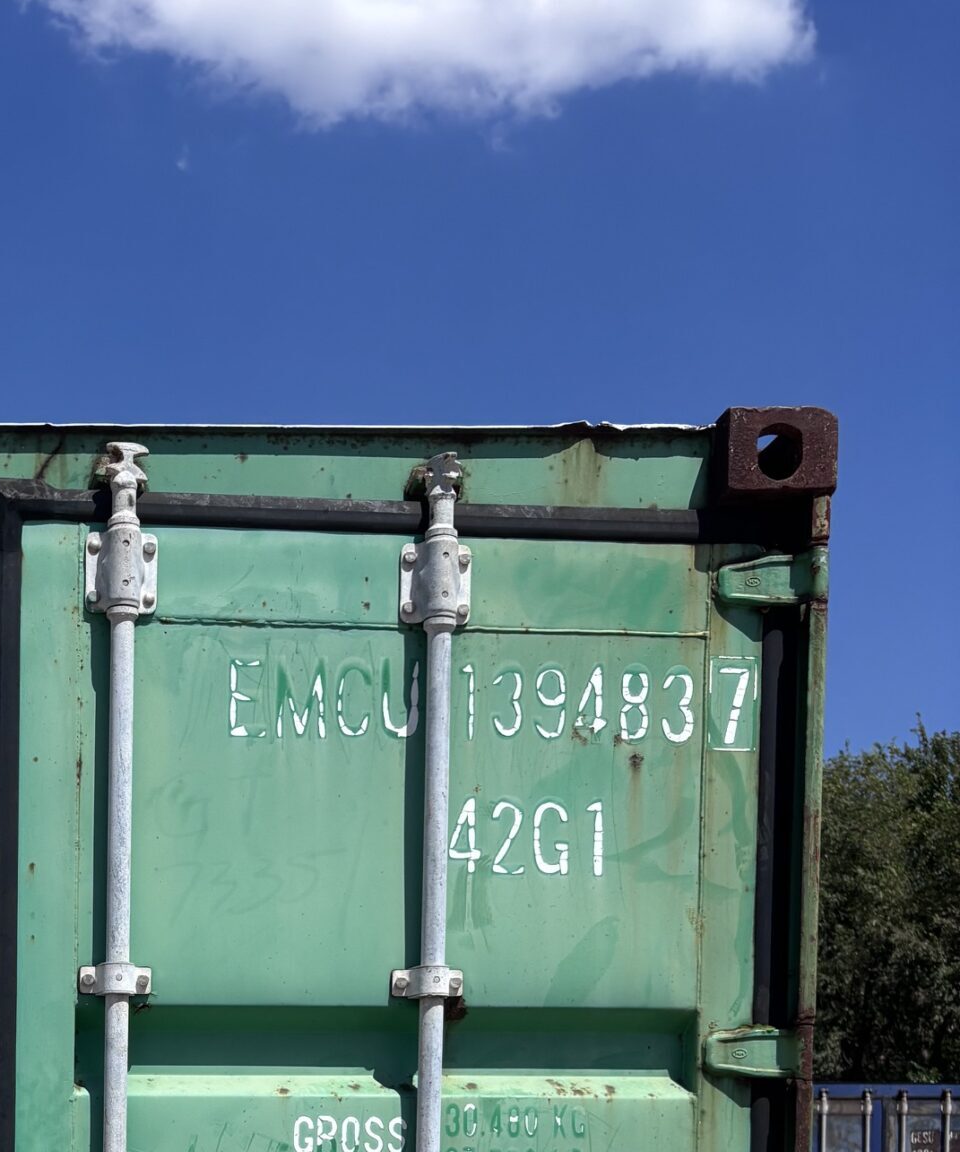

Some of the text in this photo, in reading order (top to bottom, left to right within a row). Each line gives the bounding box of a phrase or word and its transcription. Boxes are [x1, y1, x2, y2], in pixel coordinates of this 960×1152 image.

[229, 658, 419, 739] EMCU
[448, 797, 603, 876] 42G1
[553, 1104, 586, 1138] KG
